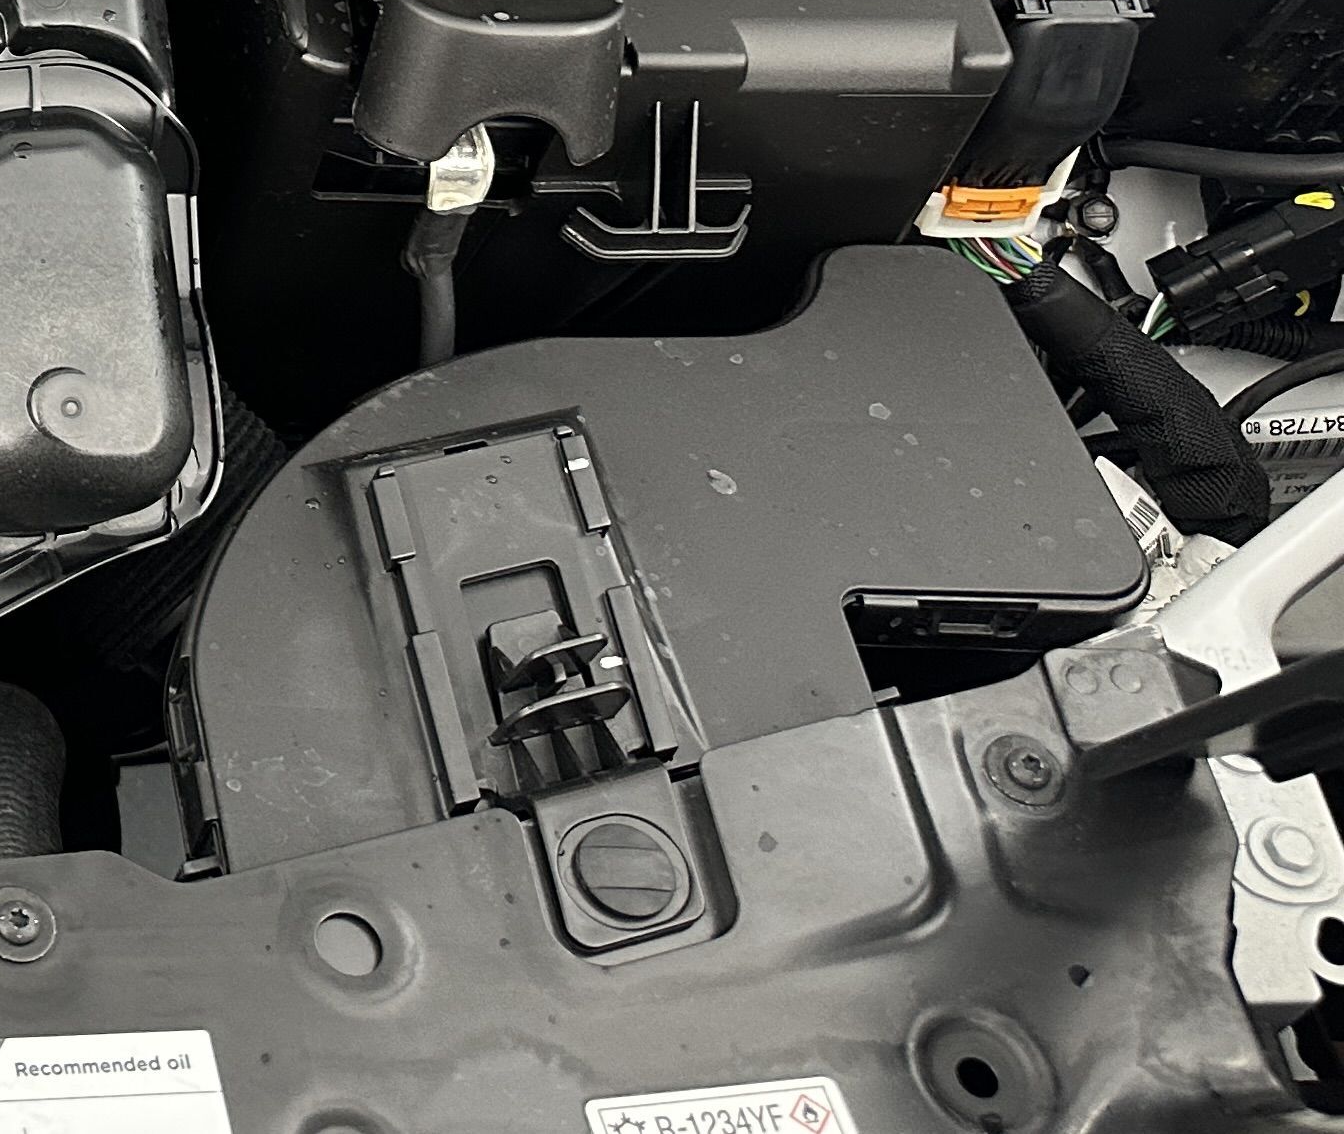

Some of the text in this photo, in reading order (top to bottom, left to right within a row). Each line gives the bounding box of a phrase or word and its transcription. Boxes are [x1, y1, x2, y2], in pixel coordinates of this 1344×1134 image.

[15, 1053, 191, 1079] Recommended oil
[655, 1104, 784, 1134] R-1234YF
